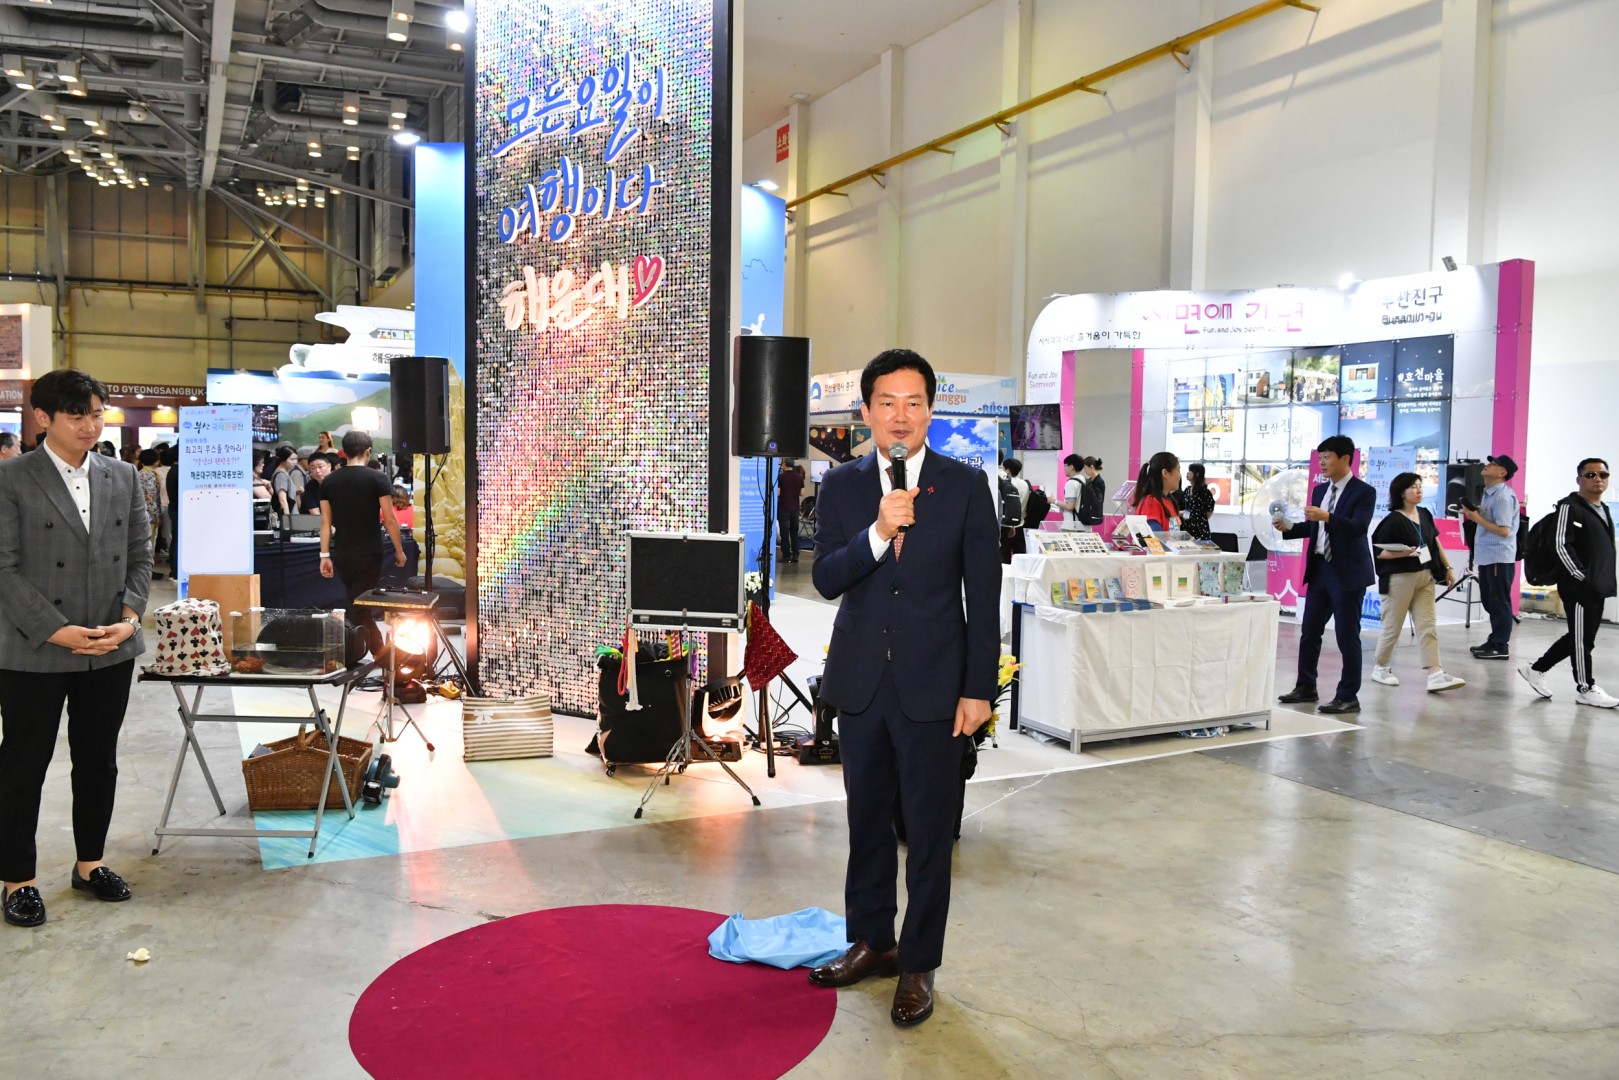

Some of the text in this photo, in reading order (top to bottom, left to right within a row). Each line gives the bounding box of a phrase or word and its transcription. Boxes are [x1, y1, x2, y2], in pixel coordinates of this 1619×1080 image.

[500, 156, 664, 242] 여행이다
[500, 262, 628, 330] 해운대
[1382, 285, 1443, 309] 부산진구
[1049, 371, 1058, 379] Joy
[108, 384, 120, 393] TO
[937, 383, 955, 393] ice
[935, 393, 967, 405] unggu
[982, 403, 1009, 415] BUSA
